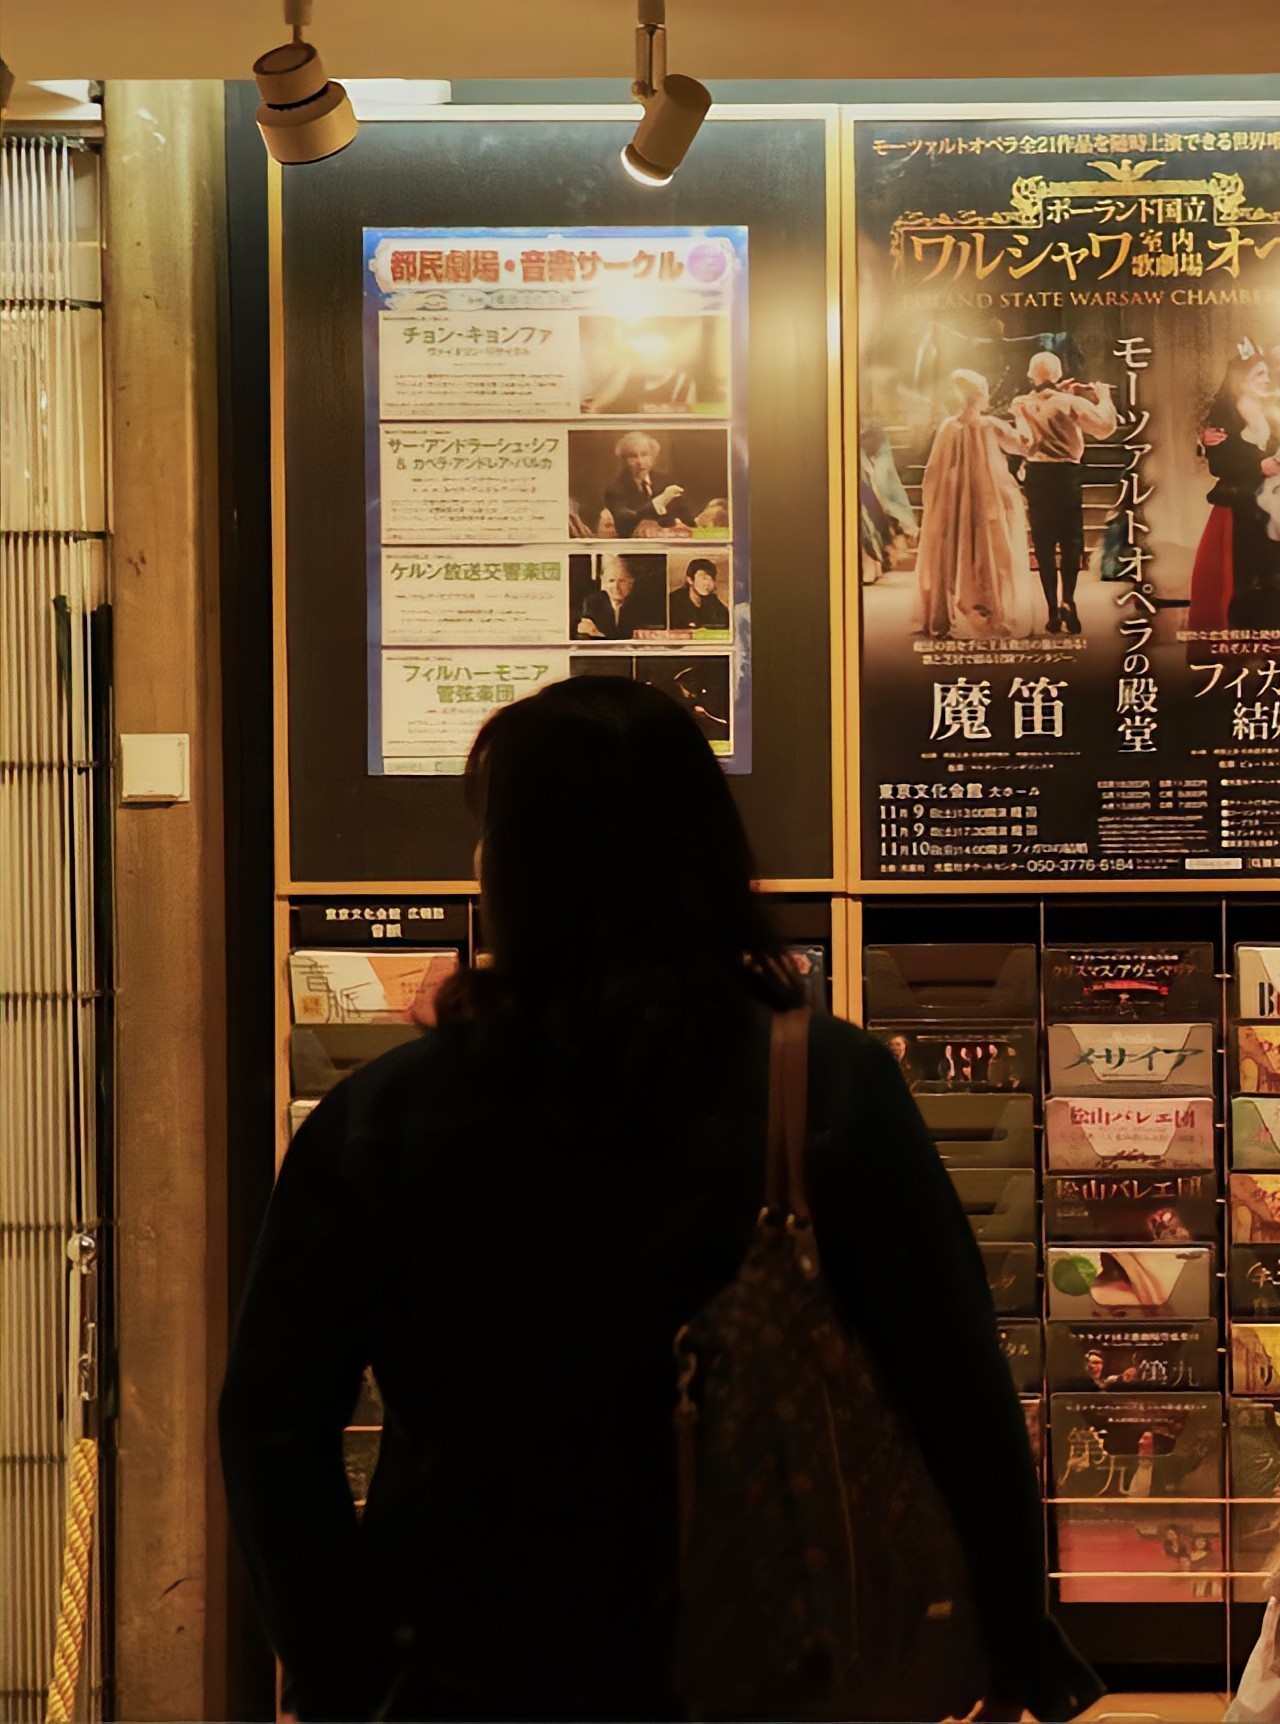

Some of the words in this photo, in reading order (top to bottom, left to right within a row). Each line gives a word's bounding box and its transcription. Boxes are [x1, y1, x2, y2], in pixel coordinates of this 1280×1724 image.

[1046, 198, 1208, 224] ポーランド国立
[911, 232, 1133, 284] ワルシャワ
[1000, 291, 1063, 308] STATE
[1070, 291, 1165, 307] WARSAW
[403, 326, 552, 345] チョン・キョンファ
[929, 676, 1069, 741] 魔笛
